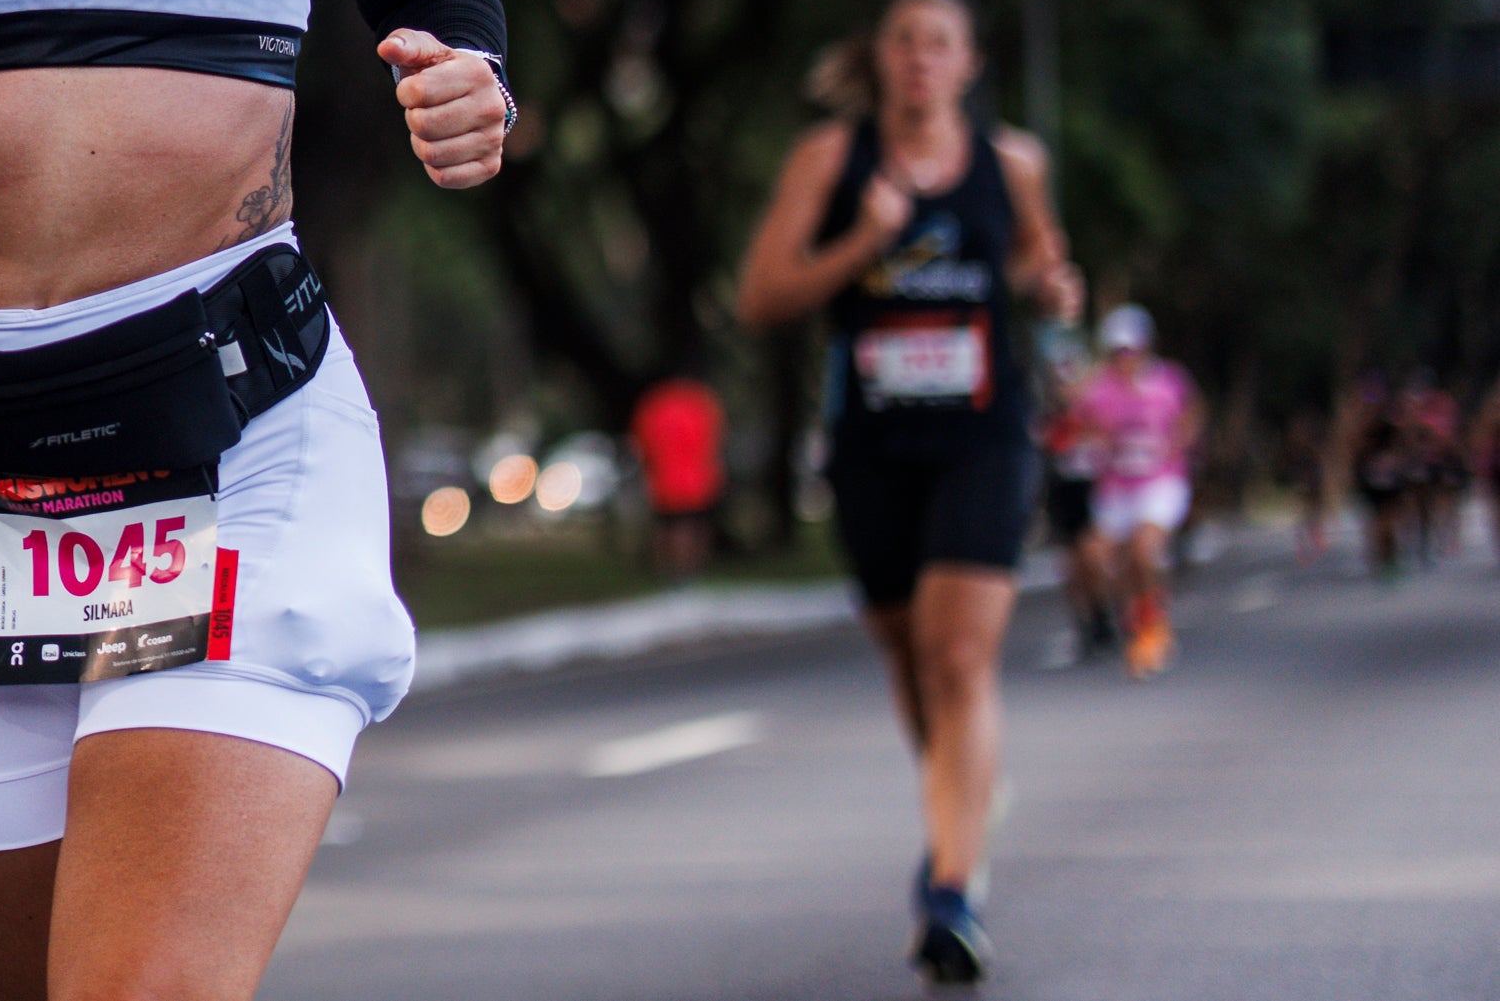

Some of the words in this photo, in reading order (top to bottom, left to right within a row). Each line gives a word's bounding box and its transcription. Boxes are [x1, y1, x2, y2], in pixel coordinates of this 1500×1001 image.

[258, 35, 295, 56] VICTORIA
[47, 423, 117, 446] FITLETIC
[42, 489, 124, 513] MARATHON
[22, 515, 186, 597] 1045
[83, 600, 133, 621] SILMARA
[212, 609, 230, 639] 1045
[97, 641, 127, 655] Jeep
